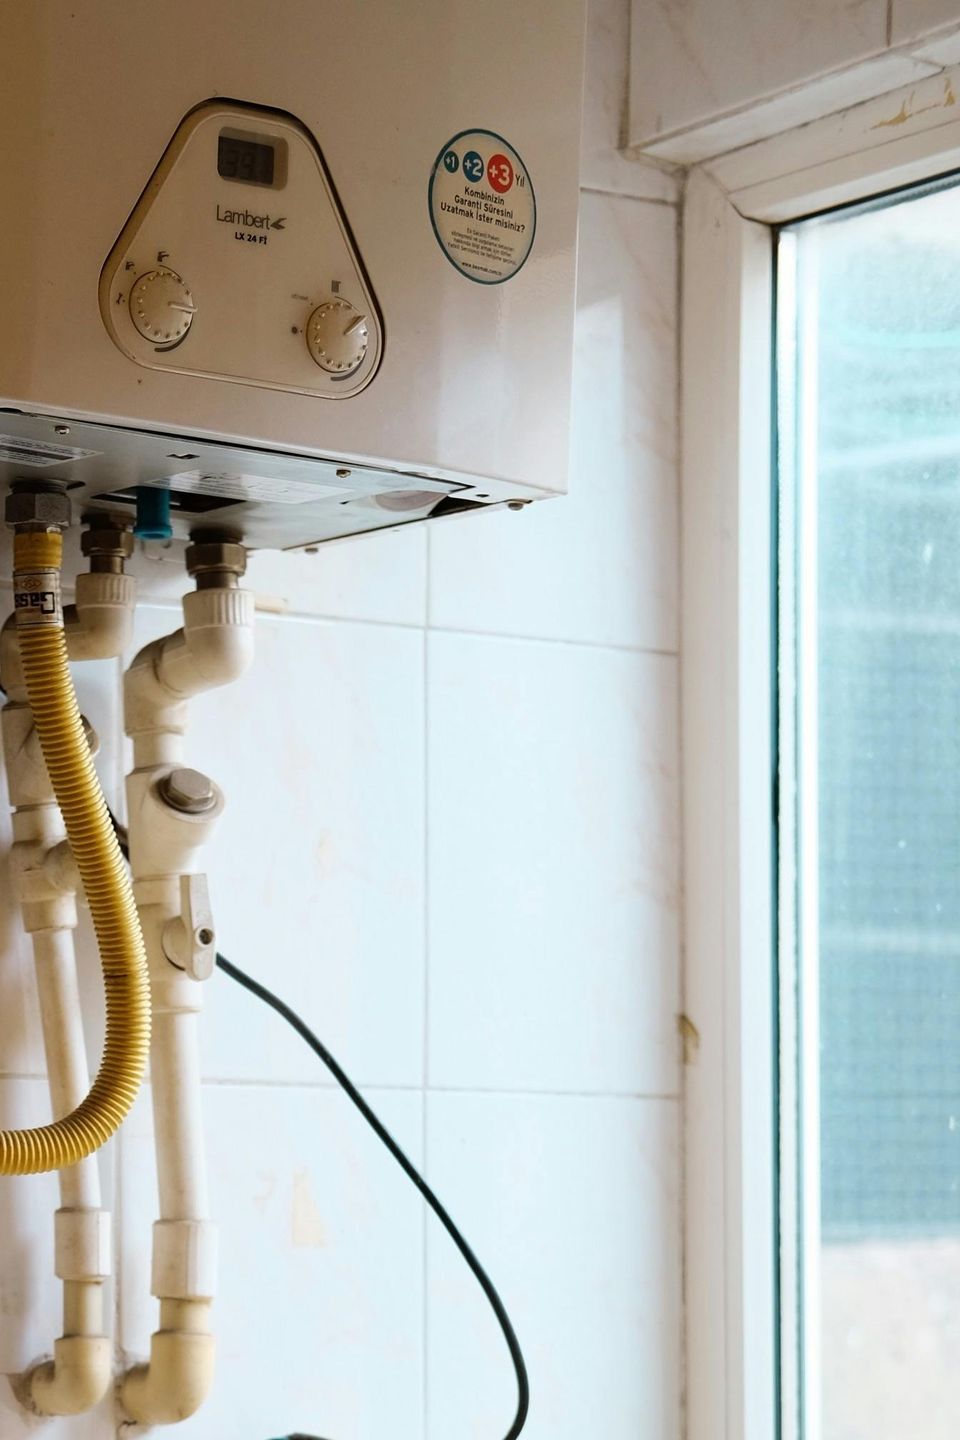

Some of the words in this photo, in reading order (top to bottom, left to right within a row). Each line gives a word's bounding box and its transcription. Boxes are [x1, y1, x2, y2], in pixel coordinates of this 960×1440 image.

[463, 158, 483, 177] +2
[489, 164, 510, 187] +3
[454, 195, 482, 210] Garanti
[464, 186, 505, 205] Kombinizin
[216, 204, 271, 231] Lambert
[440, 202, 474, 219] Uzatmak
[235, 231, 245, 241] LX
[247, 233, 257, 243] 24
